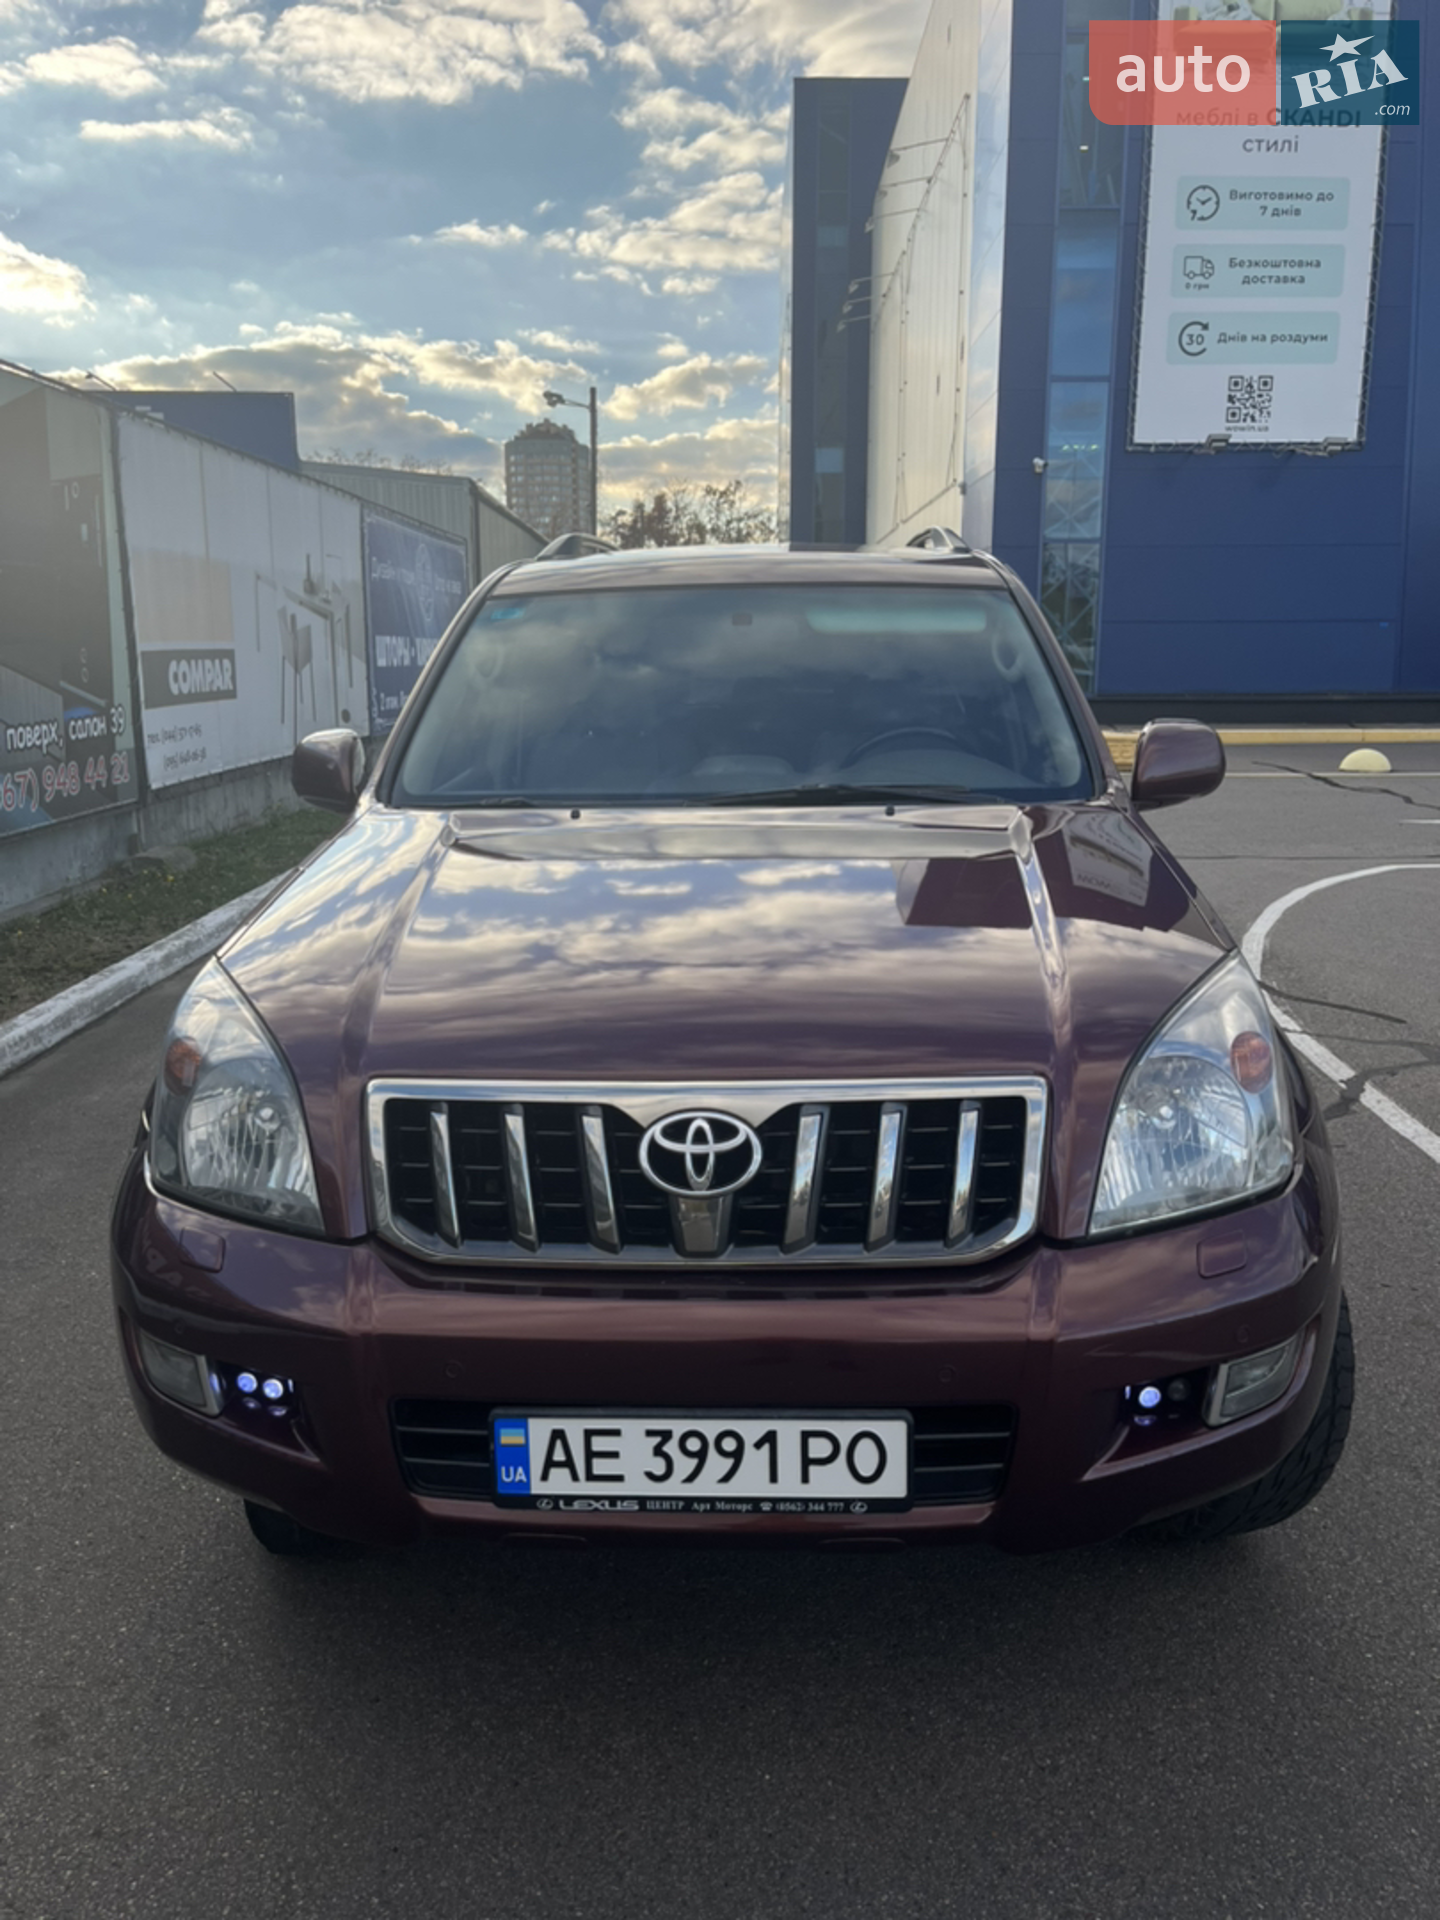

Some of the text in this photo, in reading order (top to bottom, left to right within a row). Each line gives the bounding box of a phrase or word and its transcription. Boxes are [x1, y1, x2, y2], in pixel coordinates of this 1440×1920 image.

[1176, 107, 1240, 126] меблі
[1247, 112, 1259, 126] в
[1242, 134, 1299, 153] стилі
[1229, 189, 1334, 204] Виготовимо до
[1259, 204, 1302, 218] 7 днів
[1228, 257, 1322, 270] Безкоштовна
[1241, 275, 1306, 286] доставка
[1185, 333, 1205, 346] 30
[1217, 331, 1329, 345] Днів на роздуми
[168, 658, 234, 696] COMPAR
[6, 705, 126, 755] поверх, салон 39
[42, 761, 80, 802] 948
[84, 755, 108, 791] 44
[109, 751, 131, 785] 21
[501, 1428, 888, 1485] UA AE 3991 PO
[559, 1499, 640, 1511] LEXUS
